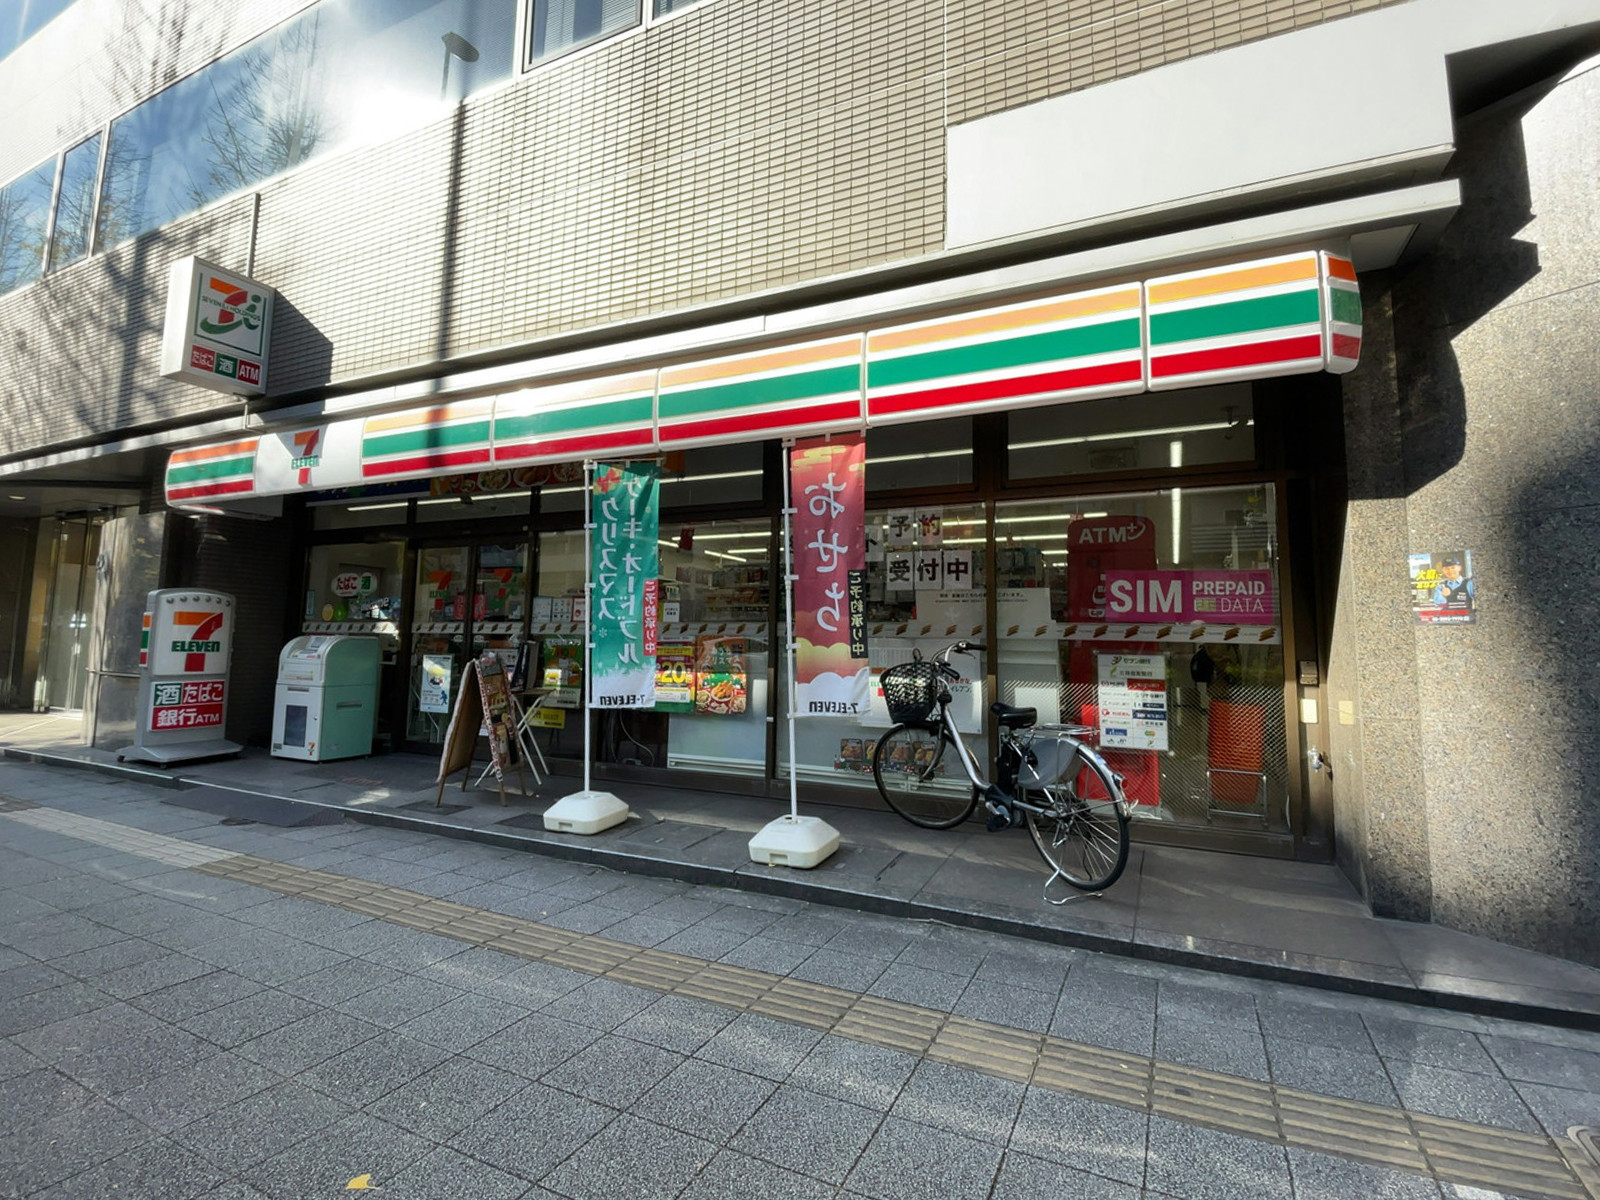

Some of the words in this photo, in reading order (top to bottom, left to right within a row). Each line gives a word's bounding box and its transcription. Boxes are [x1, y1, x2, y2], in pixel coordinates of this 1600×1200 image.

[192, 351, 213, 367] たばこ
[219, 358, 233, 373] 酒
[239, 364, 259, 380] ATM
[890, 514, 941, 537] 予約
[1079, 526, 1126, 543] ATM
[889, 558, 969, 581] 受付中
[336, 576, 358, 590] たばこ
[1110, 580, 1183, 613] SIM
[1192, 581, 1265, 595] PREPAID
[1221, 597, 1265, 613] DATA
[155, 685, 180, 705] 酒
[184, 684, 223, 702] たばこ
